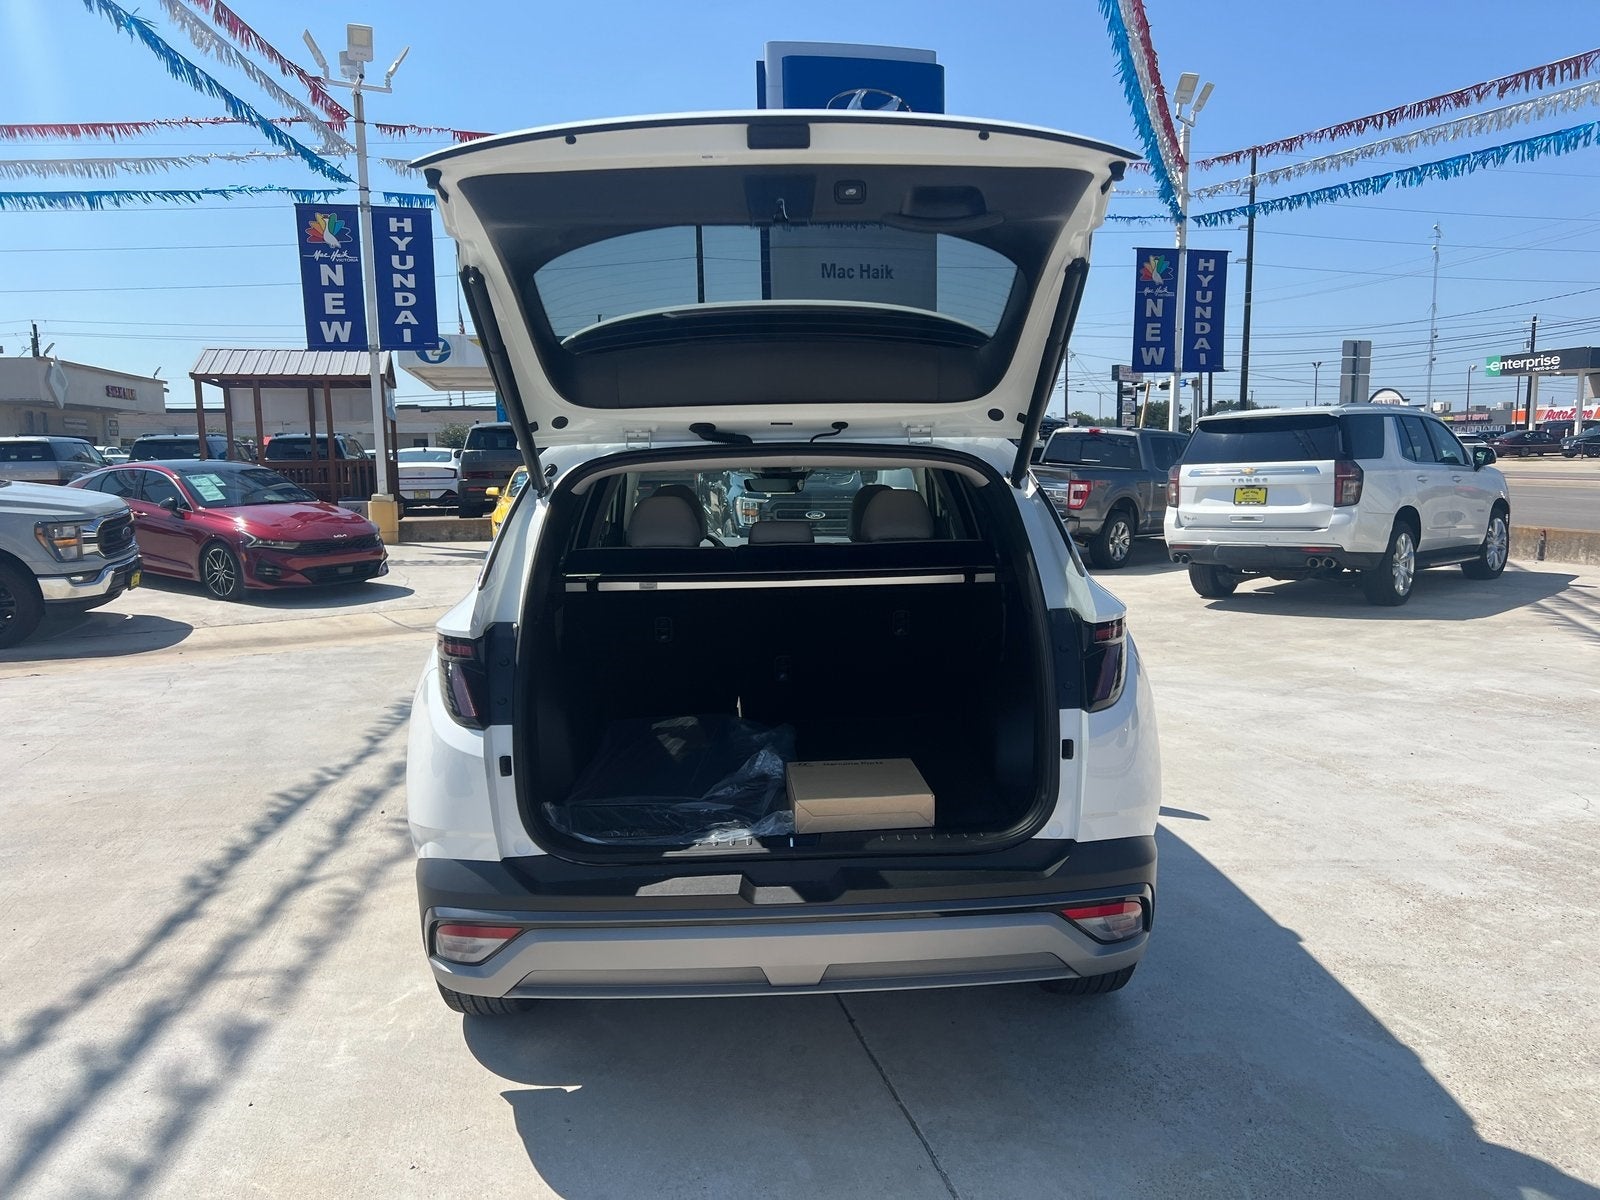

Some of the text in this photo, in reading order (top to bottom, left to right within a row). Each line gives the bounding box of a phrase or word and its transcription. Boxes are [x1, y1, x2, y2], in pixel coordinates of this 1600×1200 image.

[319, 264, 352, 343] NEW
[389, 217, 419, 343] HYUNDAI
[821, 263, 895, 280] Mac Haik
[1140, 298, 1166, 366] NEW
[1193, 258, 1215, 365] HYUNDAI
[1487, 354, 1561, 371] enterprise
[1544, 408, 1593, 420] AutoZne
